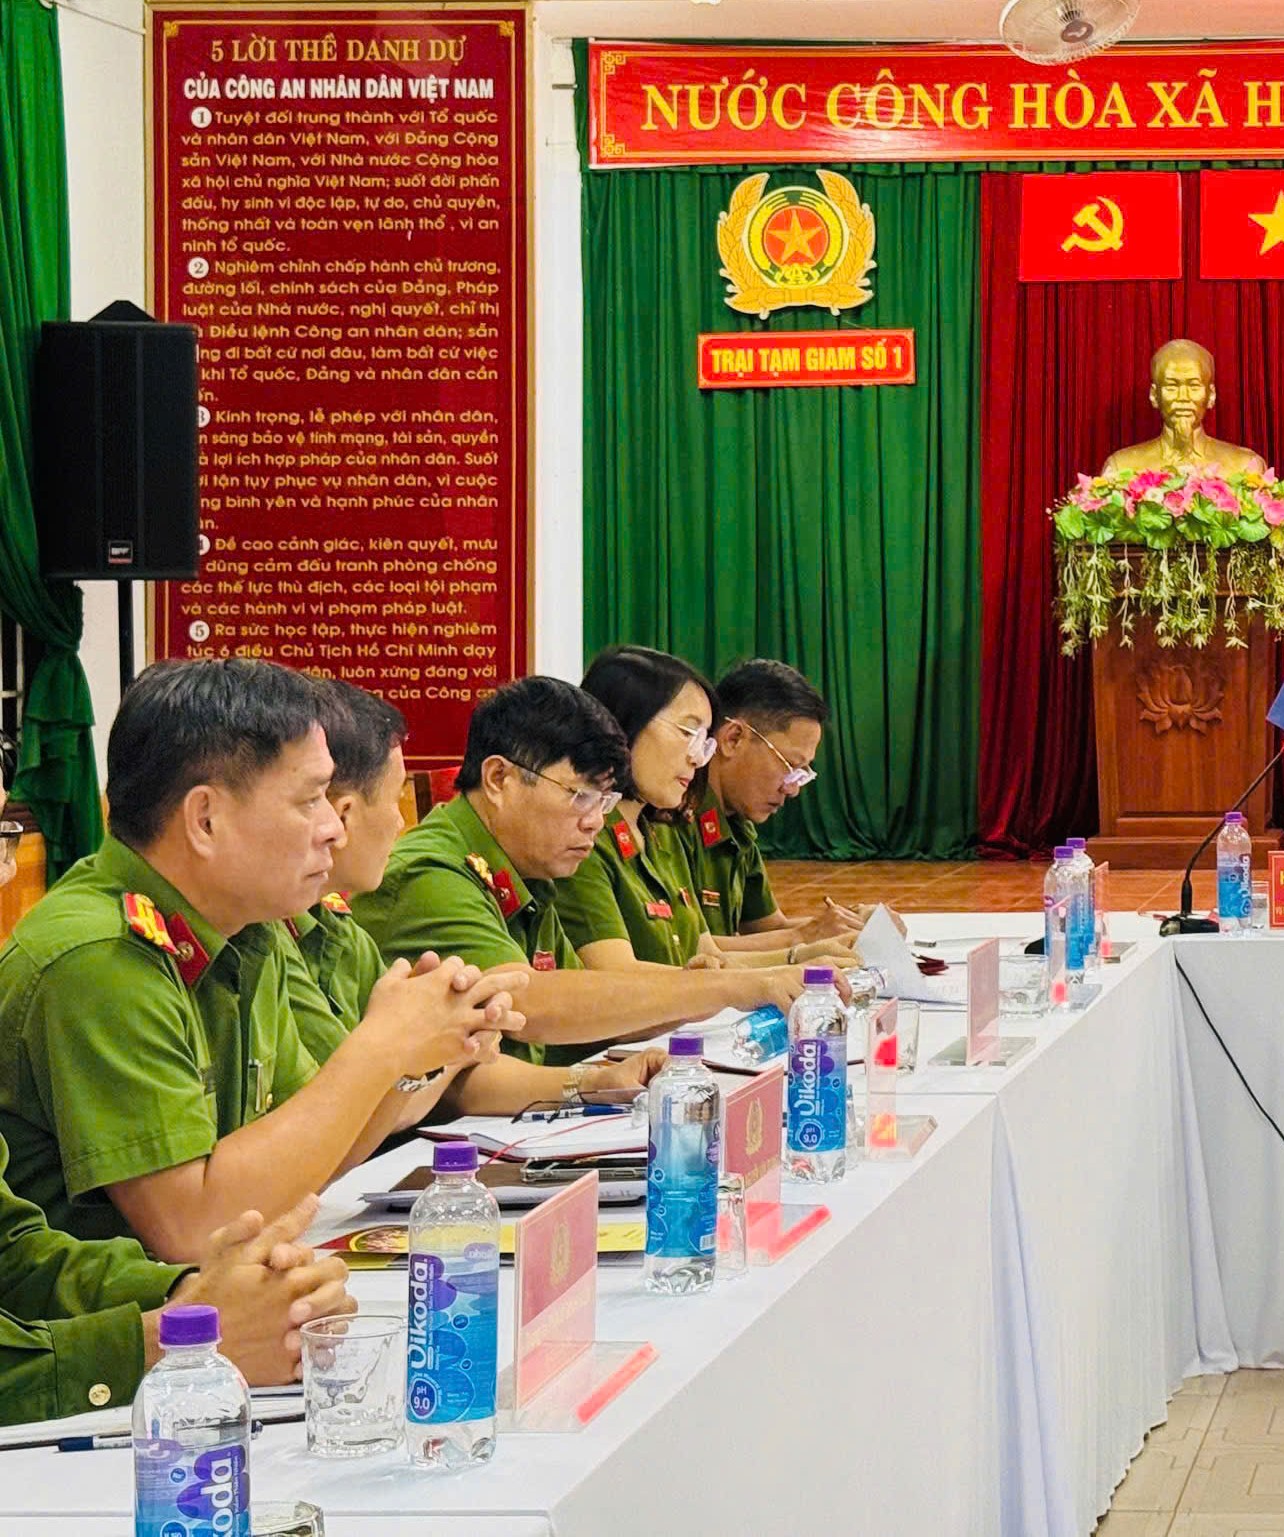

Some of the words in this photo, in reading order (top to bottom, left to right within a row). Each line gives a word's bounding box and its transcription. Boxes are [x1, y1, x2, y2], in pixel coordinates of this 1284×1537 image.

[212, 41, 223, 61] 5
[232, 34, 276, 61] LỜI
[285, 33, 336, 61] THỀ
[347, 40, 420, 61] DANH
[428, 36, 466, 65] DỰ
[184, 72, 220, 99] CỦA
[225, 75, 275, 99] CÔNG
[280, 79, 305, 98] AN
[311, 75, 360, 98] NHÂN
[366, 75, 402, 98] DÂN
[408, 74, 449, 103] VIỆT
[454, 79, 493, 98] NAM
[641, 69, 806, 131] NƯỚC
[1010, 70, 1136, 130] HÒA
[1147, 68, 1228, 128] XÃ
[215, 111, 261, 126] Tuyệt
[265, 109, 293, 124] đối
[297, 111, 341, 127] trung
[344, 110, 394, 124] thành
[398, 110, 425, 124] với
[429, 107, 449, 124] Tổ
[453, 109, 498, 126] quốc
[181, 132, 202, 146] và
[207, 132, 248, 145] nhân
[252, 132, 286, 145] dân
[290, 132, 322, 148] Việt
[326, 132, 370, 146] Nam,
[374, 131, 400, 145] với
[404, 130, 449, 148] Đảng
[453, 131, 499, 148] Cộng
[181, 152, 211, 167] sản
[215, 154, 248, 169] Việt
[252, 154, 295, 168] Nam,
[300, 153, 326, 166] với
[330, 153, 364, 166] Nhà
[369, 152, 411, 166] nước
[415, 153, 462, 169] Cộng
[466, 153, 499, 166] hòa
[214, 260, 274, 276] Nghiêm
[278, 258, 321, 273] chỉnh
[325, 259, 367, 275] chấp
[370, 260, 410, 273] hành
[414, 258, 443, 273] chủ
[447, 260, 501, 275] trương,
[711, 349, 753, 377] TRẠI
[759, 348, 800, 376] TẠM
[806, 347, 855, 371] GIAM
[861, 338, 887, 369] SỐ
[893, 346, 902, 369] 1
[215, 410, 251, 423] Kính
[255, 411, 304, 426] trọng,
[330, 410, 376, 425] phép
[380, 410, 407, 423] với
[411, 410, 455, 423] nhân
[459, 410, 498, 424] dân,
[181, 602, 202, 615] và
[207, 602, 240, 615] các
[245, 602, 287, 615] hành
[292, 602, 305, 614] vi
[310, 602, 324, 614] vi
[328, 602, 378, 617] phạm
[382, 601, 427, 617] pháp
[431, 600, 467, 616] luật.
[214, 623, 236, 636] Ra
[241, 623, 269, 636] sức
[275, 623, 307, 638] học
[312, 623, 345, 638] tập,
[350, 623, 387, 638] thực
[392, 622, 429, 638] hiện
[433, 622, 497, 638] nghiêm
[803, 1135, 818, 1143] 9.0
[408, 1260, 429, 1369] Vikoda
[416, 1386, 427, 1396] pH
[414, 1397, 430, 1410] 9.0
